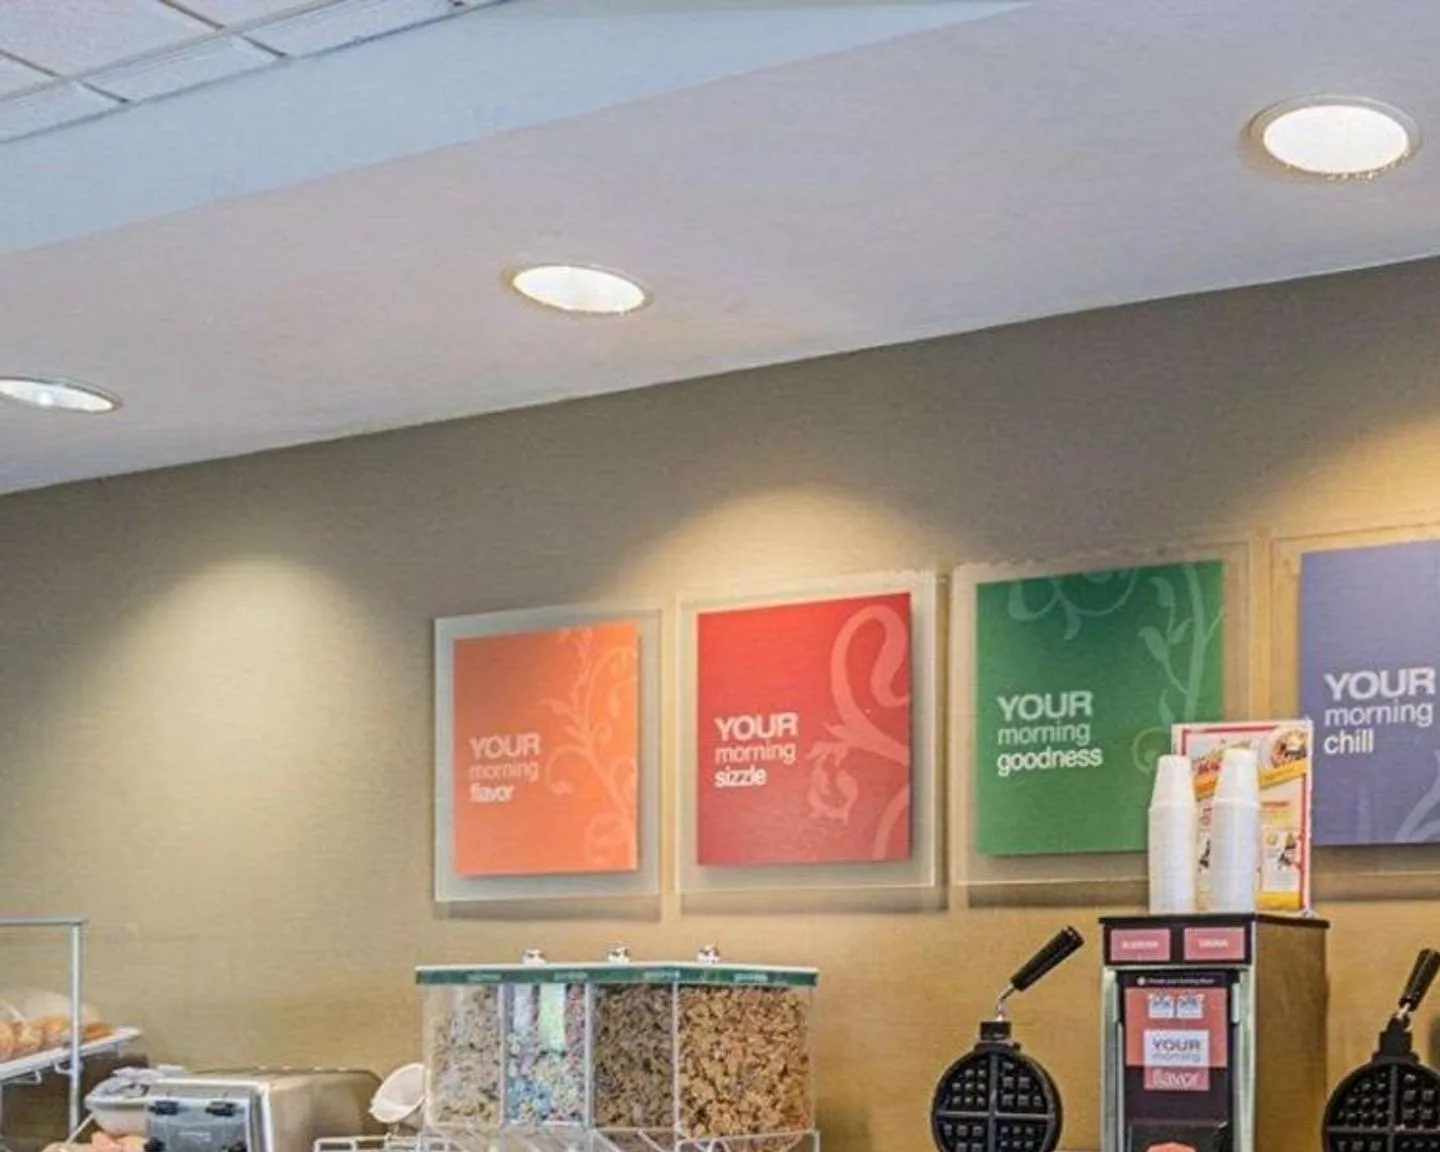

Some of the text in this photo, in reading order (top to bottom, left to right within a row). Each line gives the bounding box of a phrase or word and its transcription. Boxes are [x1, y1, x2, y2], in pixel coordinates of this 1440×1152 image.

[1323, 666, 1436, 701] YOUR
[998, 690, 1093, 721] YOUR
[1324, 699, 1434, 728] morning
[714, 712, 798, 741] YOUR
[998, 721, 1091, 746] morning
[469, 733, 541, 759] YOUR
[715, 741, 797, 765] morning
[1323, 728, 1374, 754] chill
[470, 761, 539, 782] morning
[997, 745, 1104, 777] goodness
[714, 764, 767, 788] sizzle
[1151, 1037, 1201, 1052] YOUR
